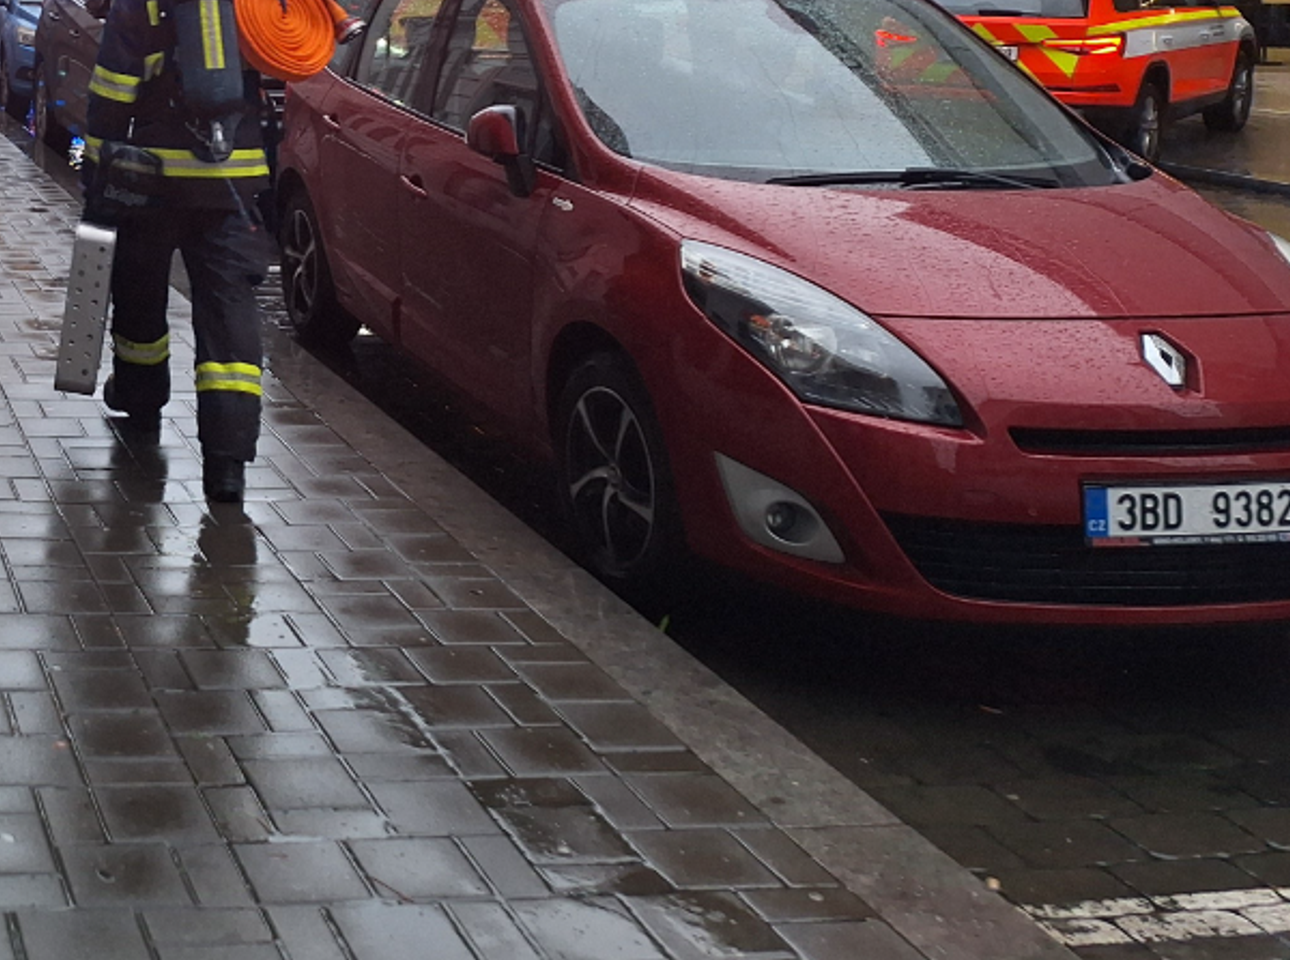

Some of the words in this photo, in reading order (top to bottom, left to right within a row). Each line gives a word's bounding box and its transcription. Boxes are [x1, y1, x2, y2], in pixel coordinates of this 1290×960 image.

[1117, 492, 1184, 531] 3BD
[1212, 489, 1290, 529] 9382
[1088, 519, 1107, 532] CZ
